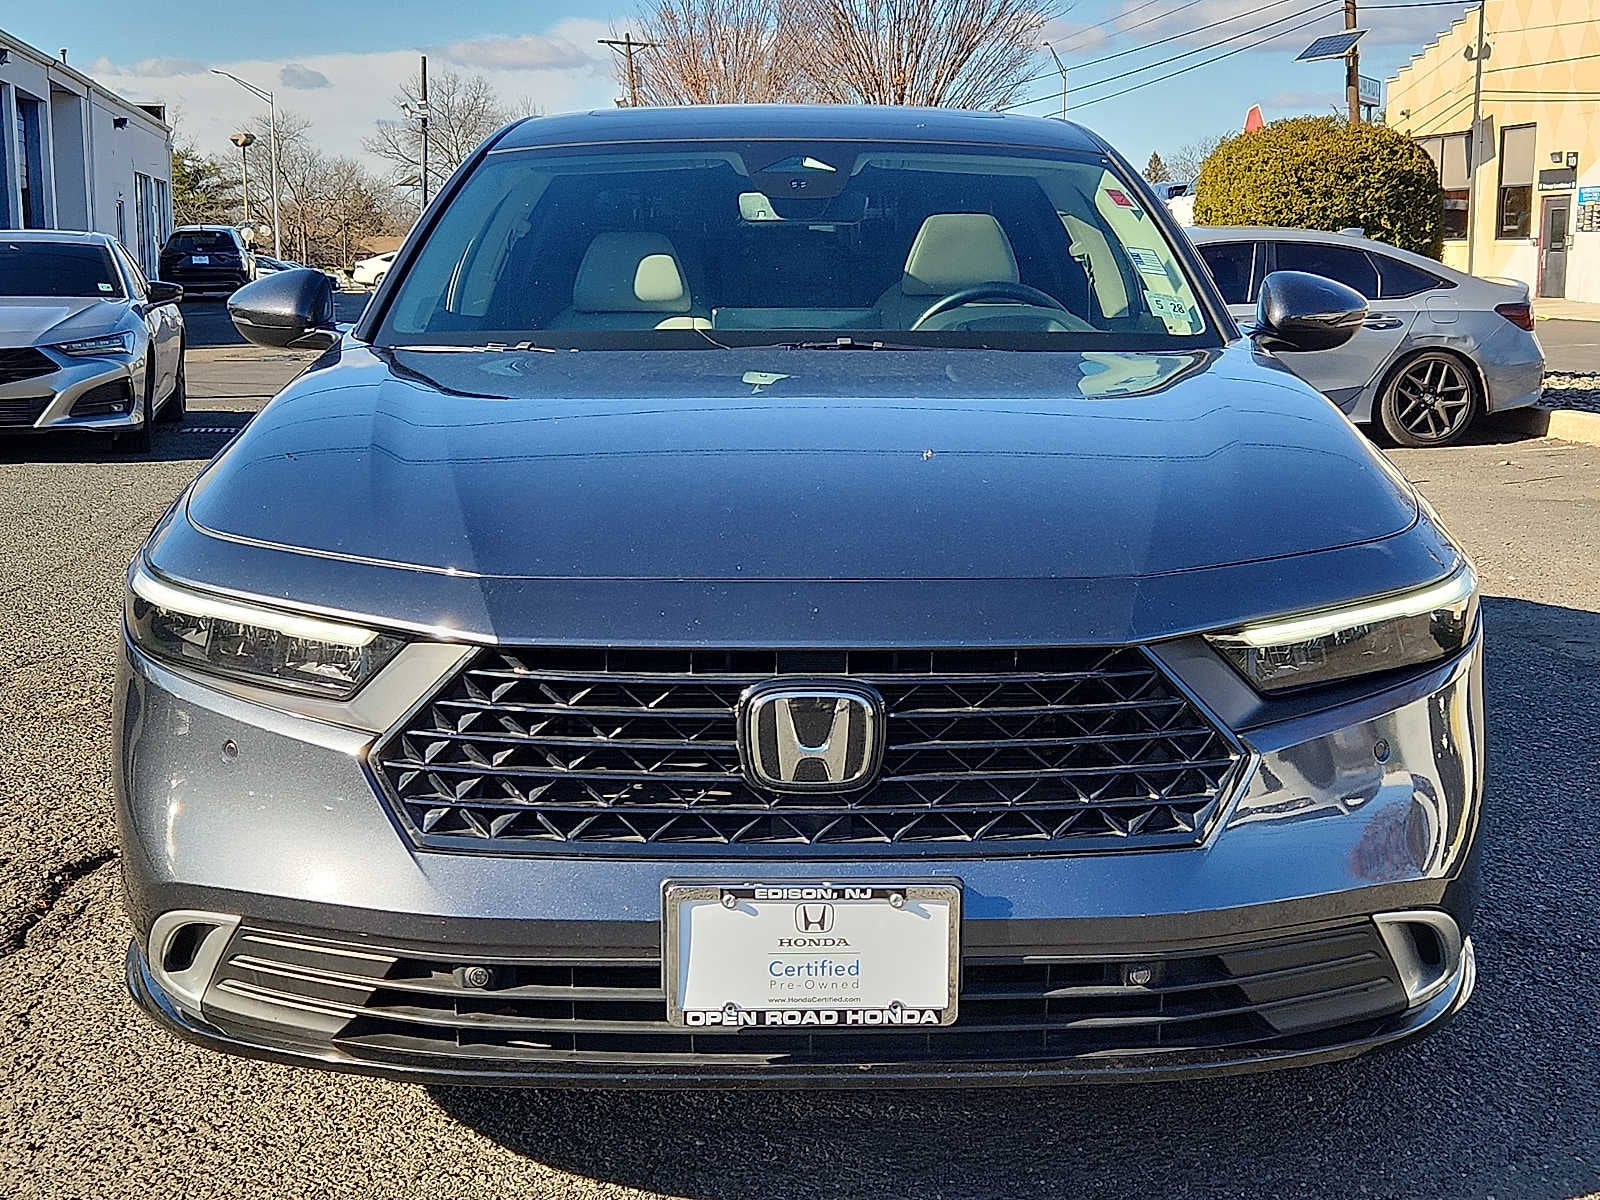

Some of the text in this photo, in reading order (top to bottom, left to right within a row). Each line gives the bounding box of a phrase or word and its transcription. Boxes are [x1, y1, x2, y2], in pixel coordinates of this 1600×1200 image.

[1155, 299, 1185, 314] 5 28
[754, 888, 873, 900] EDISON, NJ
[778, 938, 850, 947] HONDA
[769, 959, 860, 977] Certified
[769, 979, 860, 990] Pre-Owned
[686, 1009, 939, 1025] OPEN ROAD HONDA
